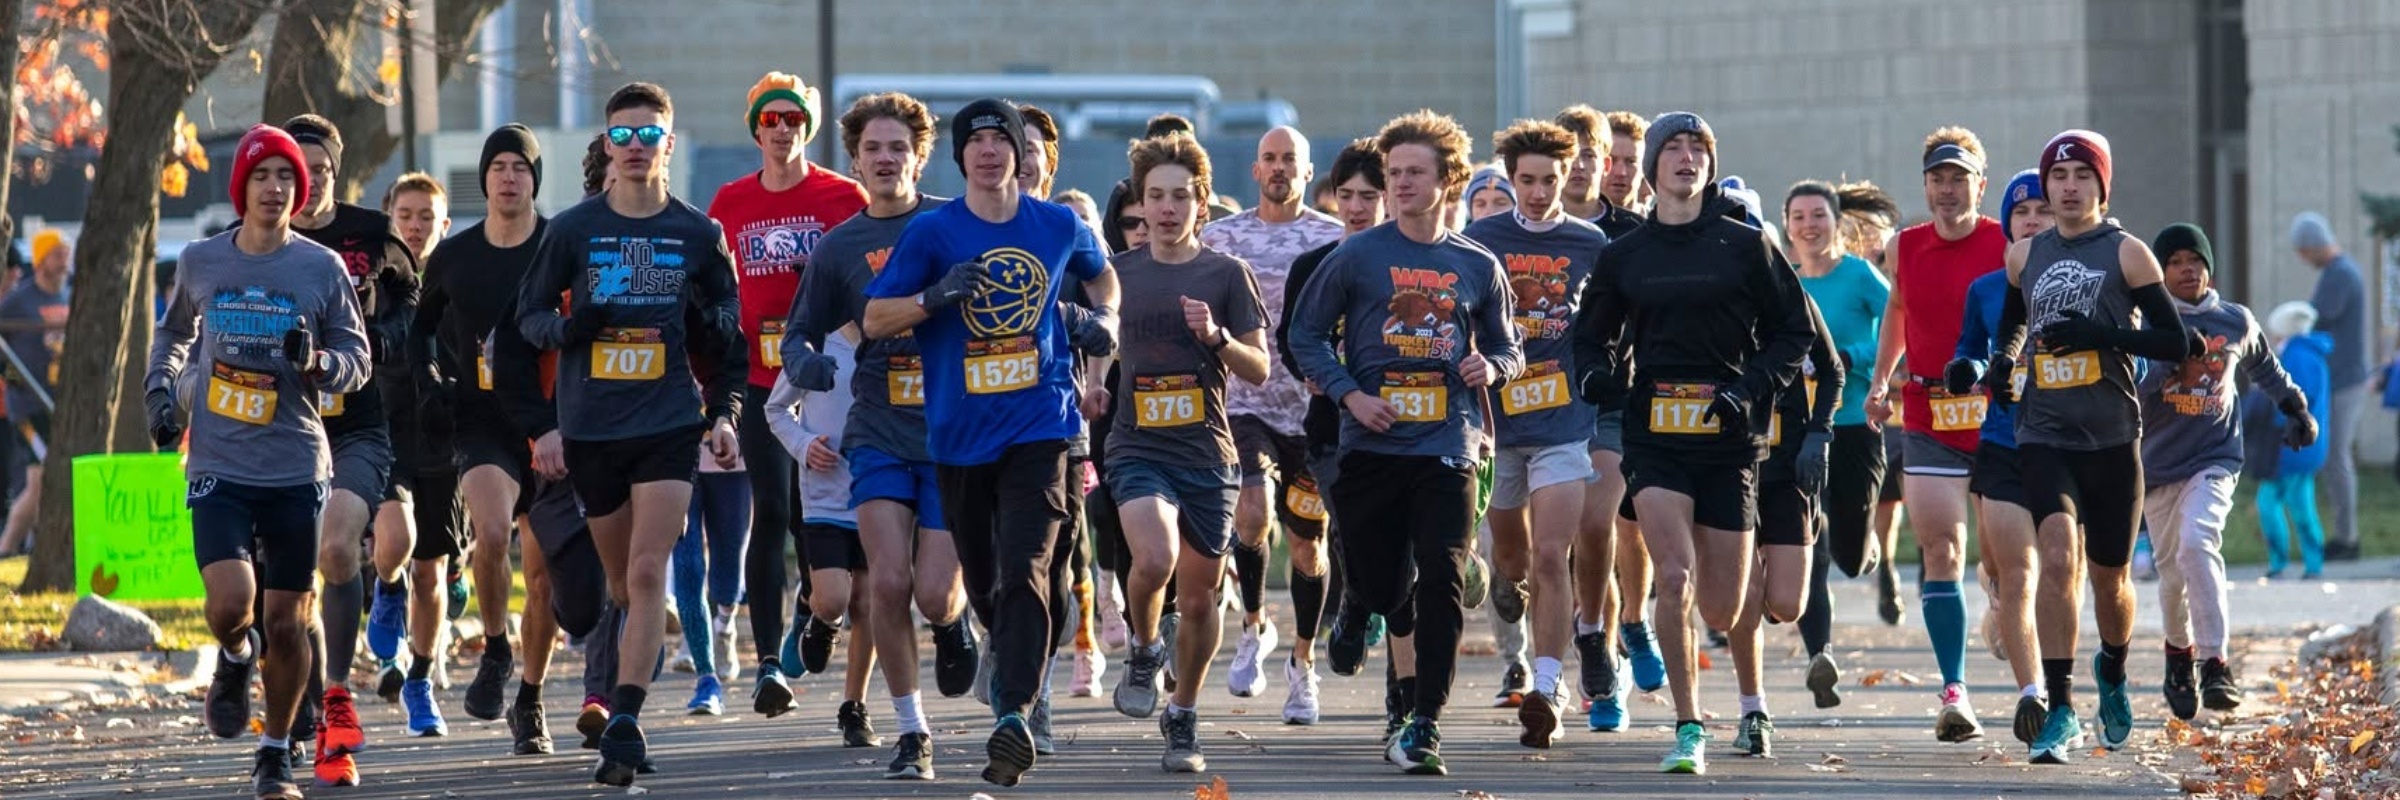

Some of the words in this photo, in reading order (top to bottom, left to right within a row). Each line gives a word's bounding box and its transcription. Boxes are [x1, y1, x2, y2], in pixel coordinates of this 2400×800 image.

[2055, 143, 2075, 161] K
[620, 243, 654, 268] NO
[738, 236, 765, 262] LB
[217, 302, 246, 310] CROSS
[248, 304, 291, 315] COUNTRY
[207, 310, 294, 337] REGIONA
[1383, 334, 1432, 347] TURKEY
[1398, 346, 1432, 358] TROT
[602, 348, 654, 373] 707
[967, 356, 1036, 389] 1525
[2042, 356, 2088, 384] 567
[218, 384, 265, 418] 713
[1391, 392, 1436, 417] 531
[1511, 378, 1557, 408] 937
[1144, 395, 1193, 422] 376
[1933, 399, 1986, 426] 1373
